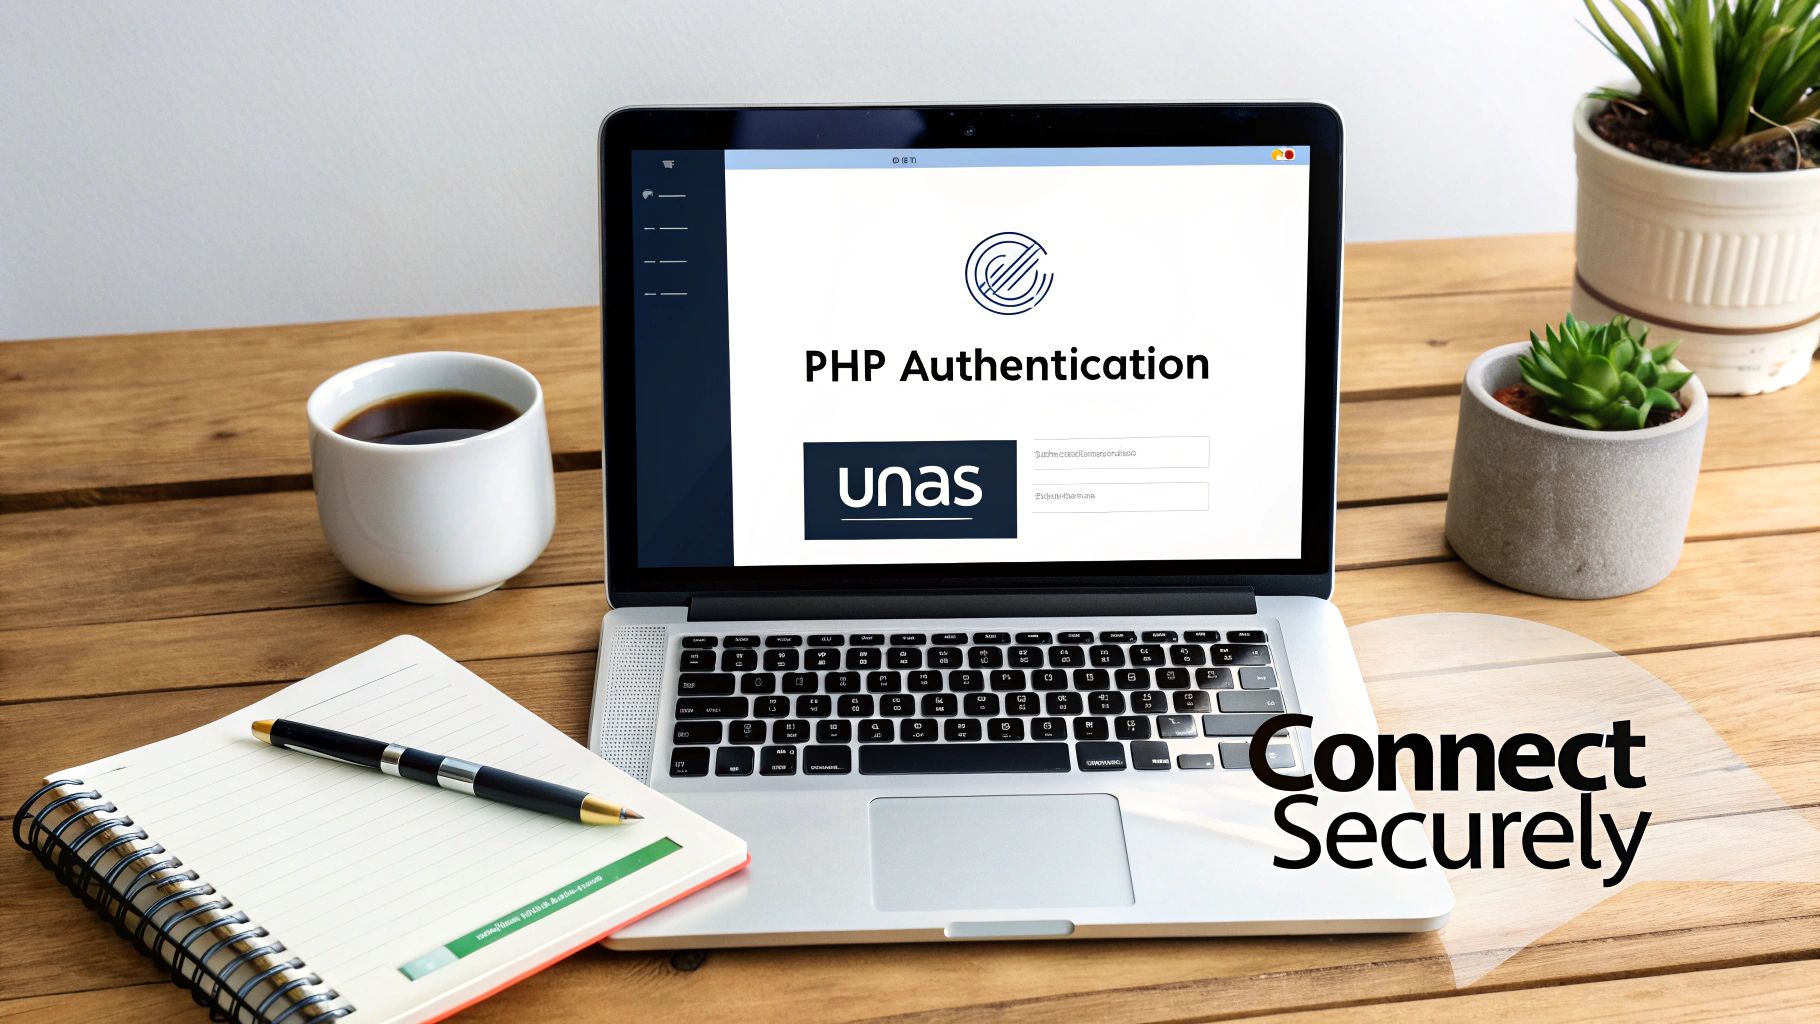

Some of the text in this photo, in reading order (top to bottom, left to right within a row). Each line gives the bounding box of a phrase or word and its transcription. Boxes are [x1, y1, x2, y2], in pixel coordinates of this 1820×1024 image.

[805, 347, 1209, 383] PHP Authentication
[838, 465, 983, 508] unas
